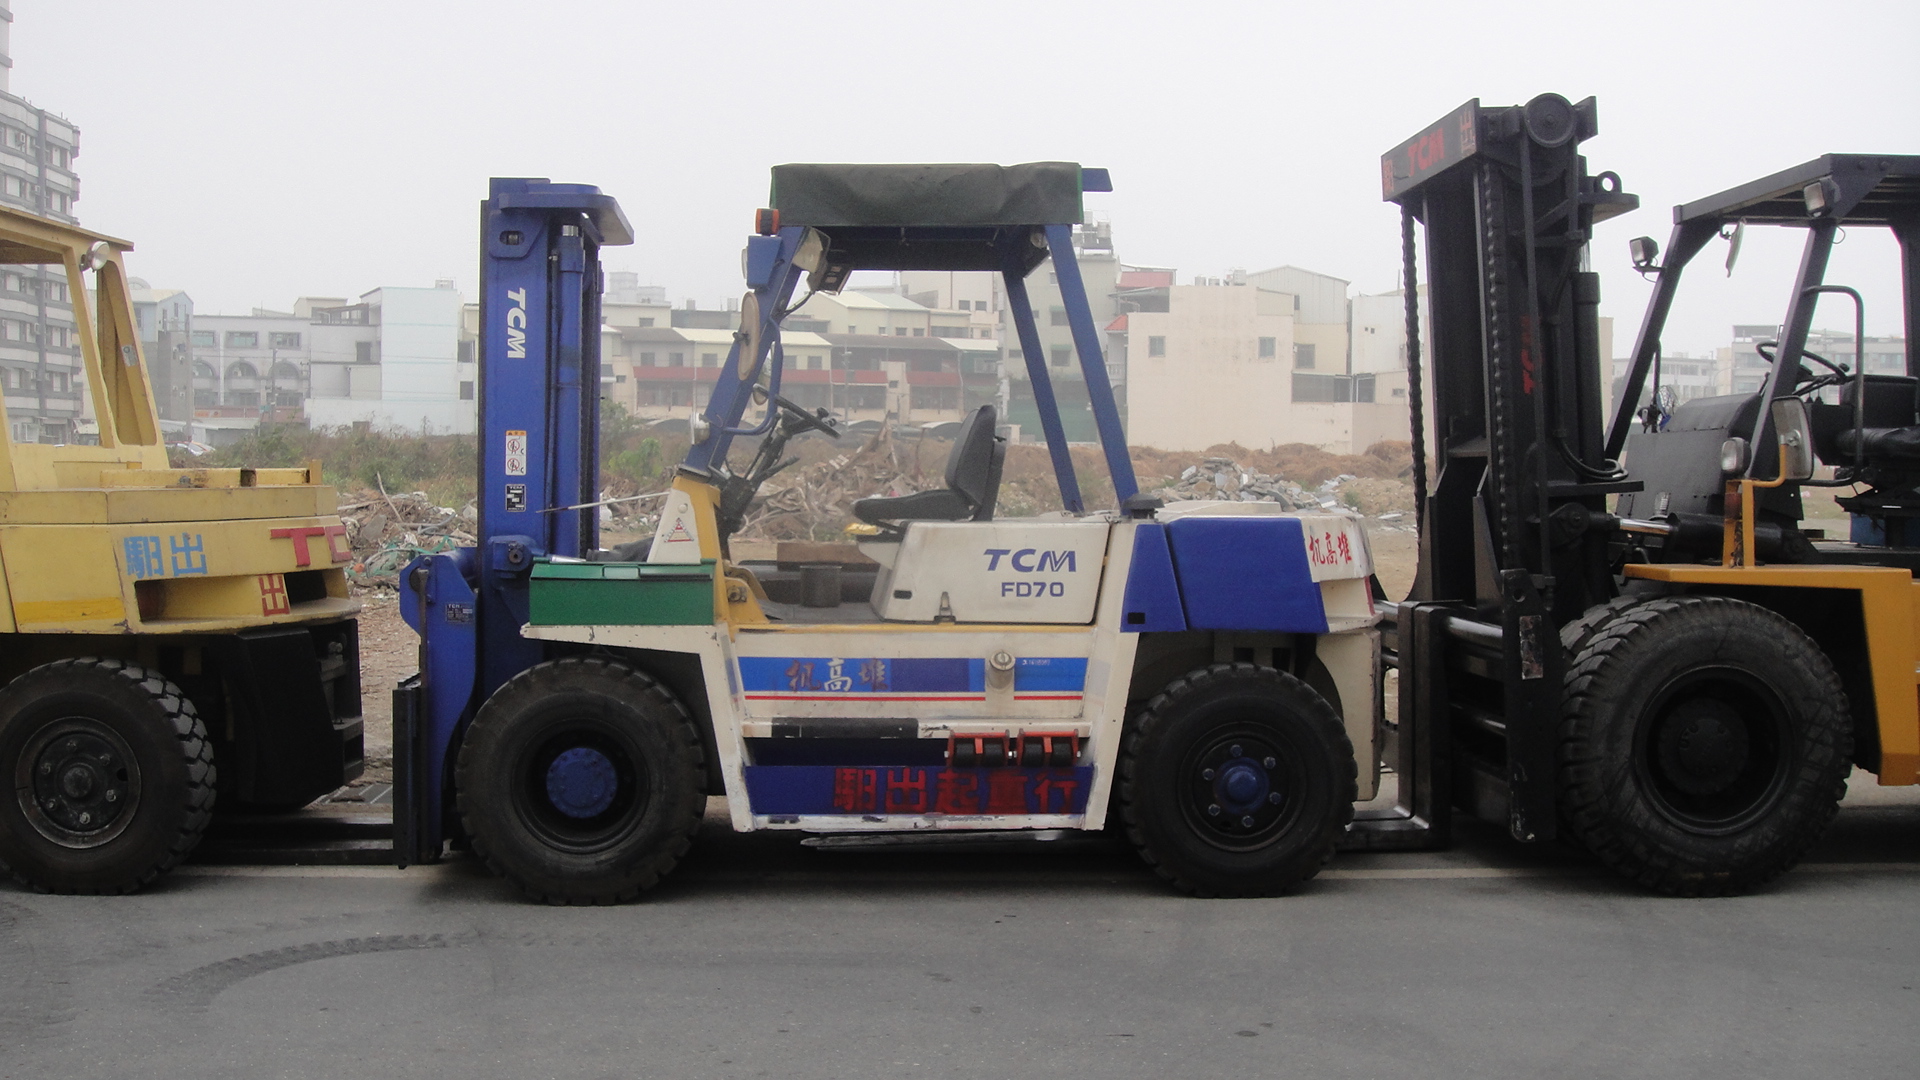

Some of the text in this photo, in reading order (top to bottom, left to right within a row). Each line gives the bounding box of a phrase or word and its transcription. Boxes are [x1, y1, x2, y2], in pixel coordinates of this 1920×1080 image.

[1408, 128, 1445, 177] TCM
[507, 287, 527, 358] TCM
[983, 548, 1077, 573] TCM
[1001, 582, 1064, 597] FD70
